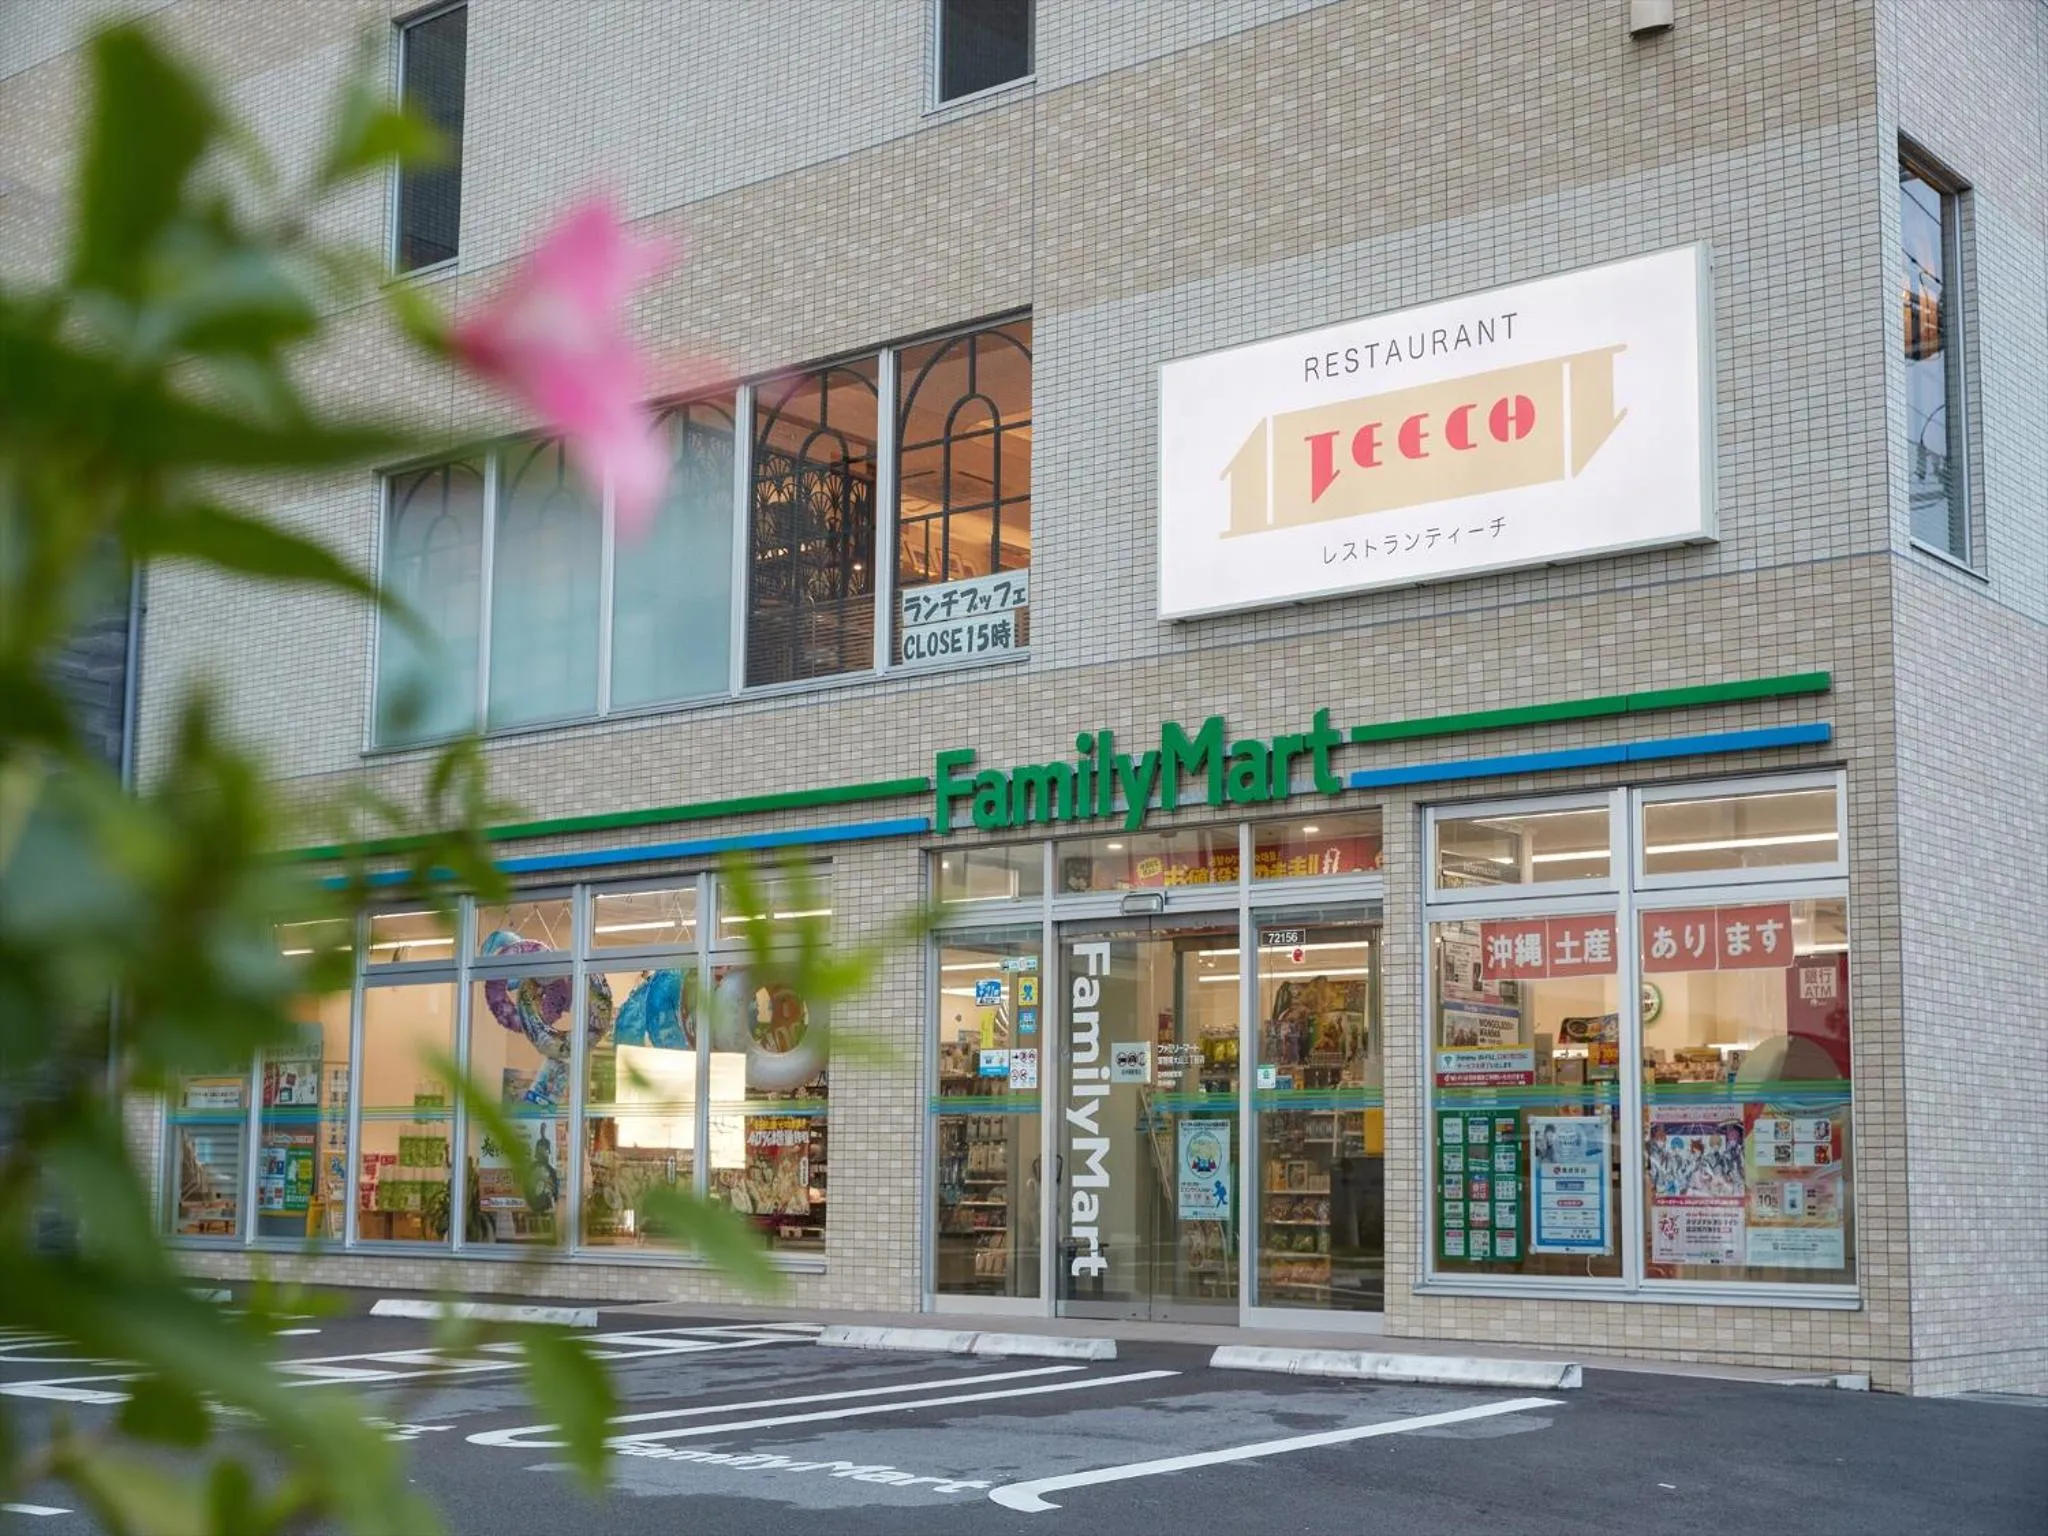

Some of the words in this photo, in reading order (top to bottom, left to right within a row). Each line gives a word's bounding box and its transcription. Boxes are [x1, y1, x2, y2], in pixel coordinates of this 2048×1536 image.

[1304, 312, 1519, 382] RESTAURANT
[1322, 516, 1507, 565] レストランティーチ
[904, 581, 1026, 622] ランチブッフェ
[935, 707, 1342, 834] FamilyMart
[1268, 932, 1299, 944] 72156
[1804, 968, 1833, 984] 銀行
[1805, 984, 1832, 997] ATM
[1066, 942, 1111, 1277] FamilyMart
